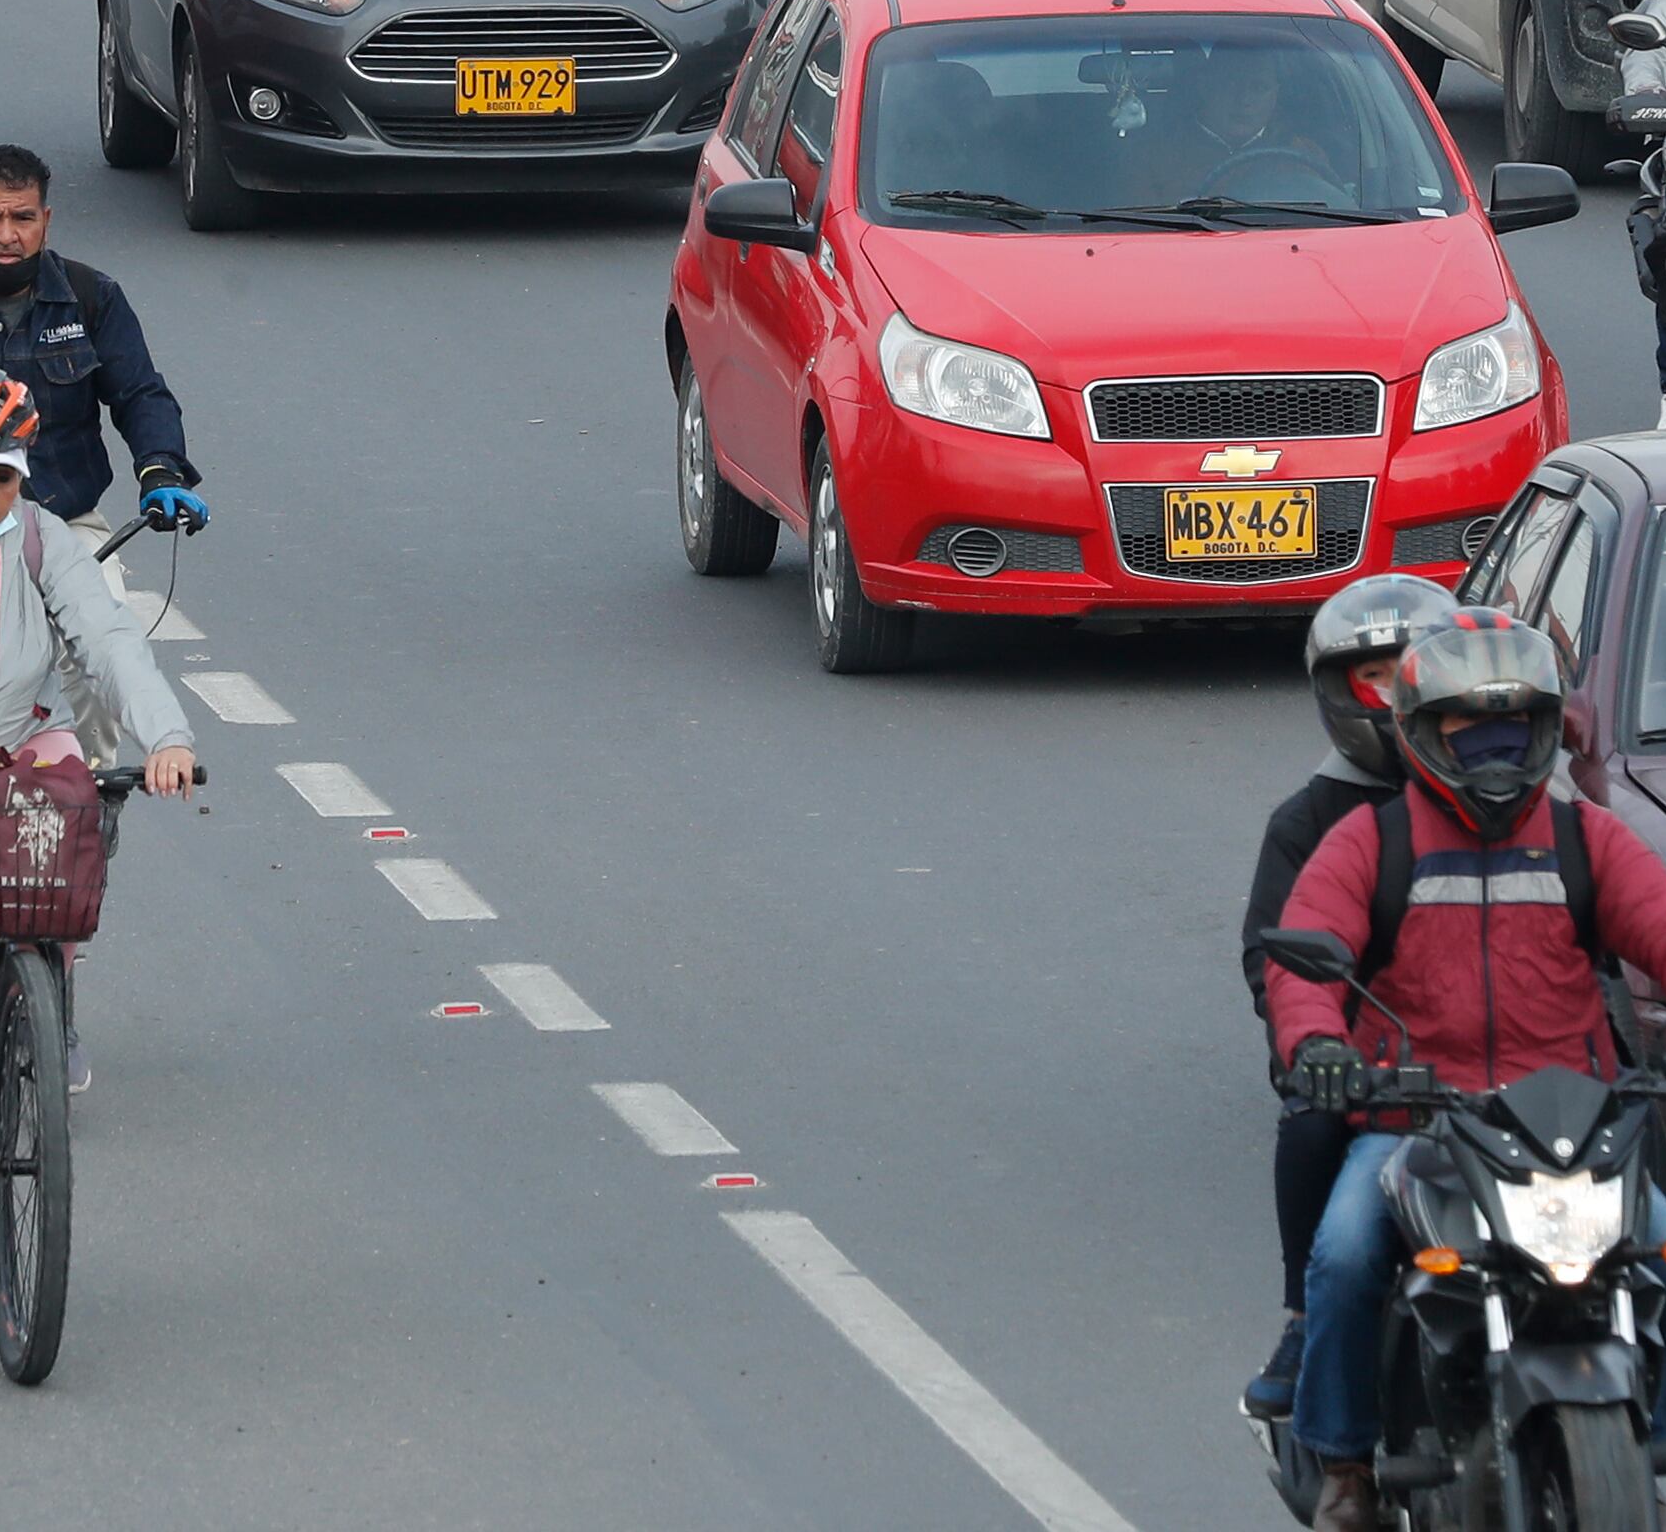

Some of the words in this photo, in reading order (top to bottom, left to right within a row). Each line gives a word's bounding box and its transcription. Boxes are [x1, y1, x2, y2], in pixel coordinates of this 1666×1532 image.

[486, 102, 522, 111] BOGOTA
[1204, 542, 1251, 554] BOGOTA
[1257, 542, 1281, 553] D.C.
